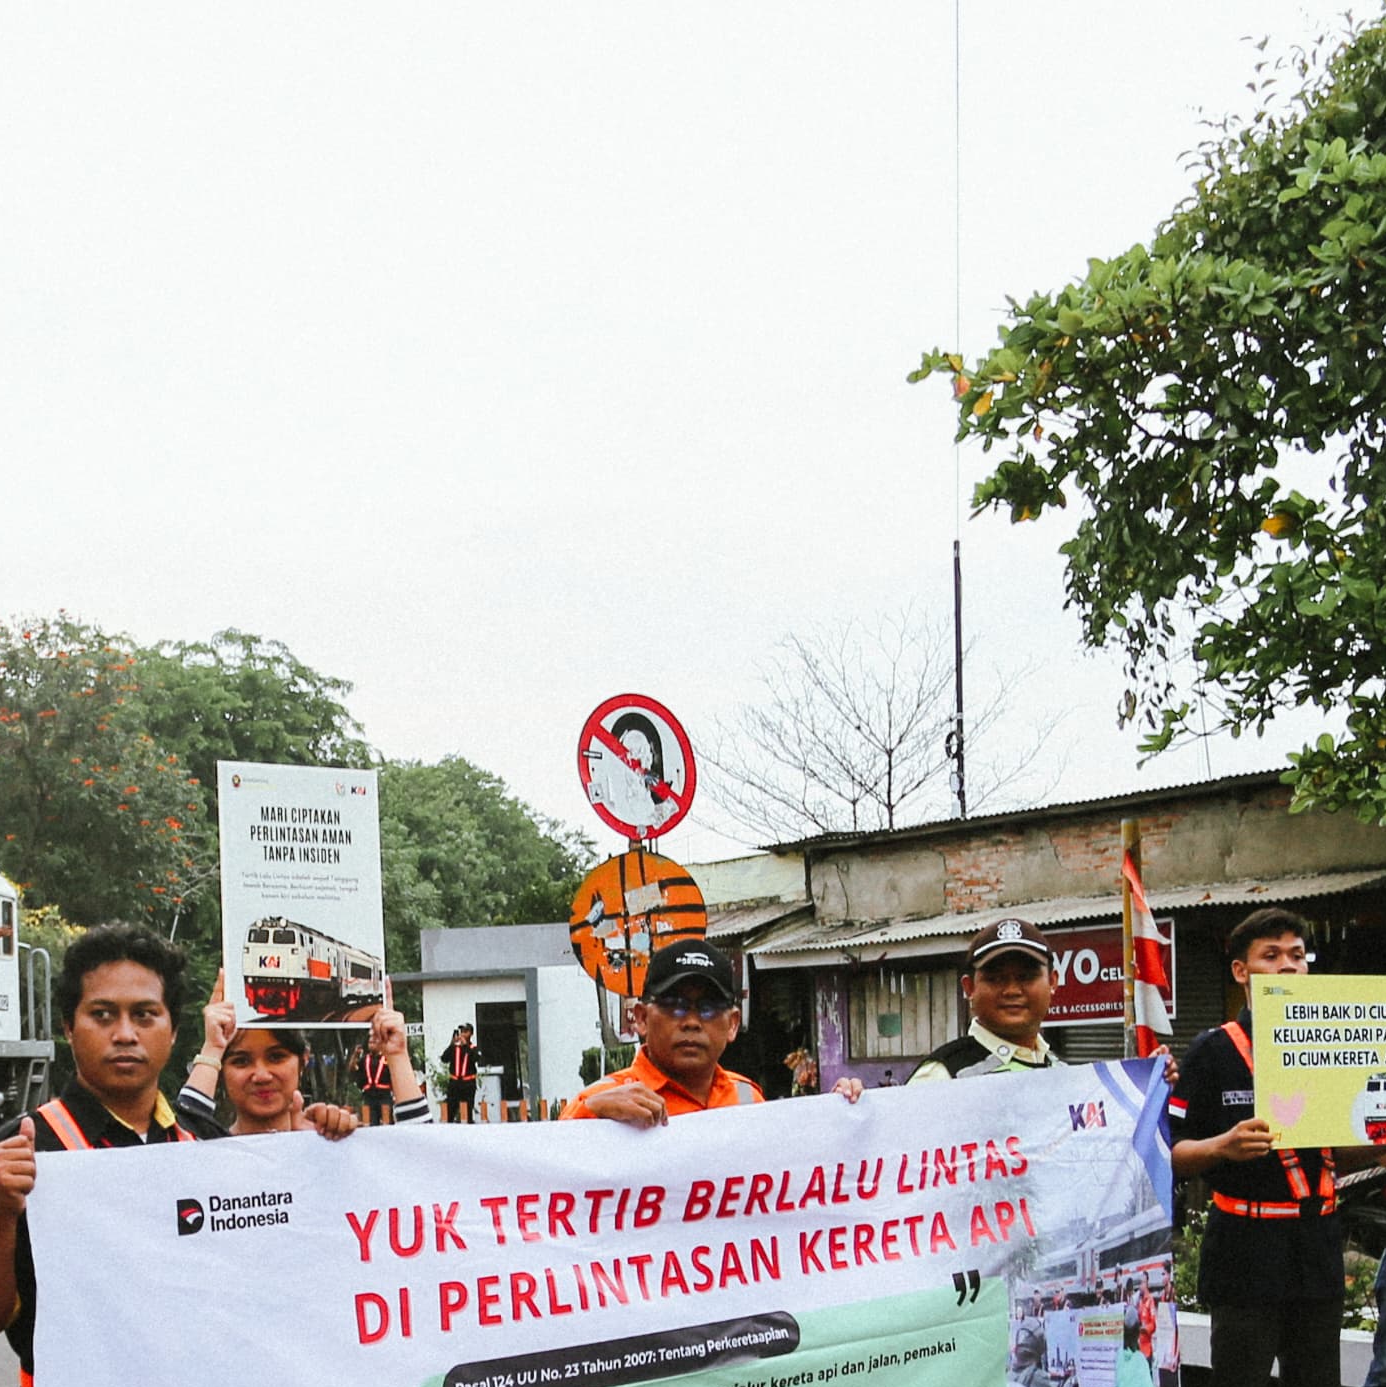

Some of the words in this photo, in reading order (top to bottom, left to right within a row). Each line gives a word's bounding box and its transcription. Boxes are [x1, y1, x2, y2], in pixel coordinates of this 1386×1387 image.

[261, 806, 287, 822] MARI
[291, 807, 340, 825] CIPTAKAN
[250, 825, 318, 843] PERLINTASAN
[322, 829, 352, 845] AMAN
[263, 845, 296, 863] TANPA
[299, 847, 340, 864] INSIDEN
[259, 955, 280, 969] KAI
[1070, 1003, 1123, 1013] ACCESSORIES
[1285, 1005, 1319, 1020] LEBIH
[1322, 1005, 1351, 1019] BAIK
[1355, 1006, 1366, 1019] DI
[1273, 1028, 1341, 1044] KELUARGA
[1344, 1028, 1372, 1042] DARI
[1283, 1052, 1295, 1066] DI
[1299, 1052, 1330, 1066] CIUM
[1334, 1051, 1379, 1065] KERETA
[1070, 1102, 1107, 1133] KAI
[208, 1191, 293, 1213] Danantara
[346, 1201, 468, 1263] YUK
[481, 1186, 665, 1246] TERTIB
[683, 1156, 883, 1224] BERLALU
[897, 1136, 1029, 1196] LINTAS
[210, 1208, 289, 1232] Indonesia
[355, 1287, 412, 1346] DI
[438, 1234, 781, 1332] PERLINTASAN
[800, 1213, 957, 1277] KERETA
[970, 1198, 1036, 1247] API
[517, 1371, 537, 1386] UU
[540, 1367, 561, 1382] No.
[565, 1363, 579, 1378] 23
[582, 1354, 621, 1375] Tahun
[624, 1349, 656, 1368] 2007:
[658, 1341, 705, 1363] Tentang
[707, 1326, 789, 1353] Perkeretaapian
[817, 1364, 838, 1382] api
[841, 1360, 865, 1377] dan
[867, 1352, 901, 1373] jalan,
[904, 1337, 956, 1364] pemakai
